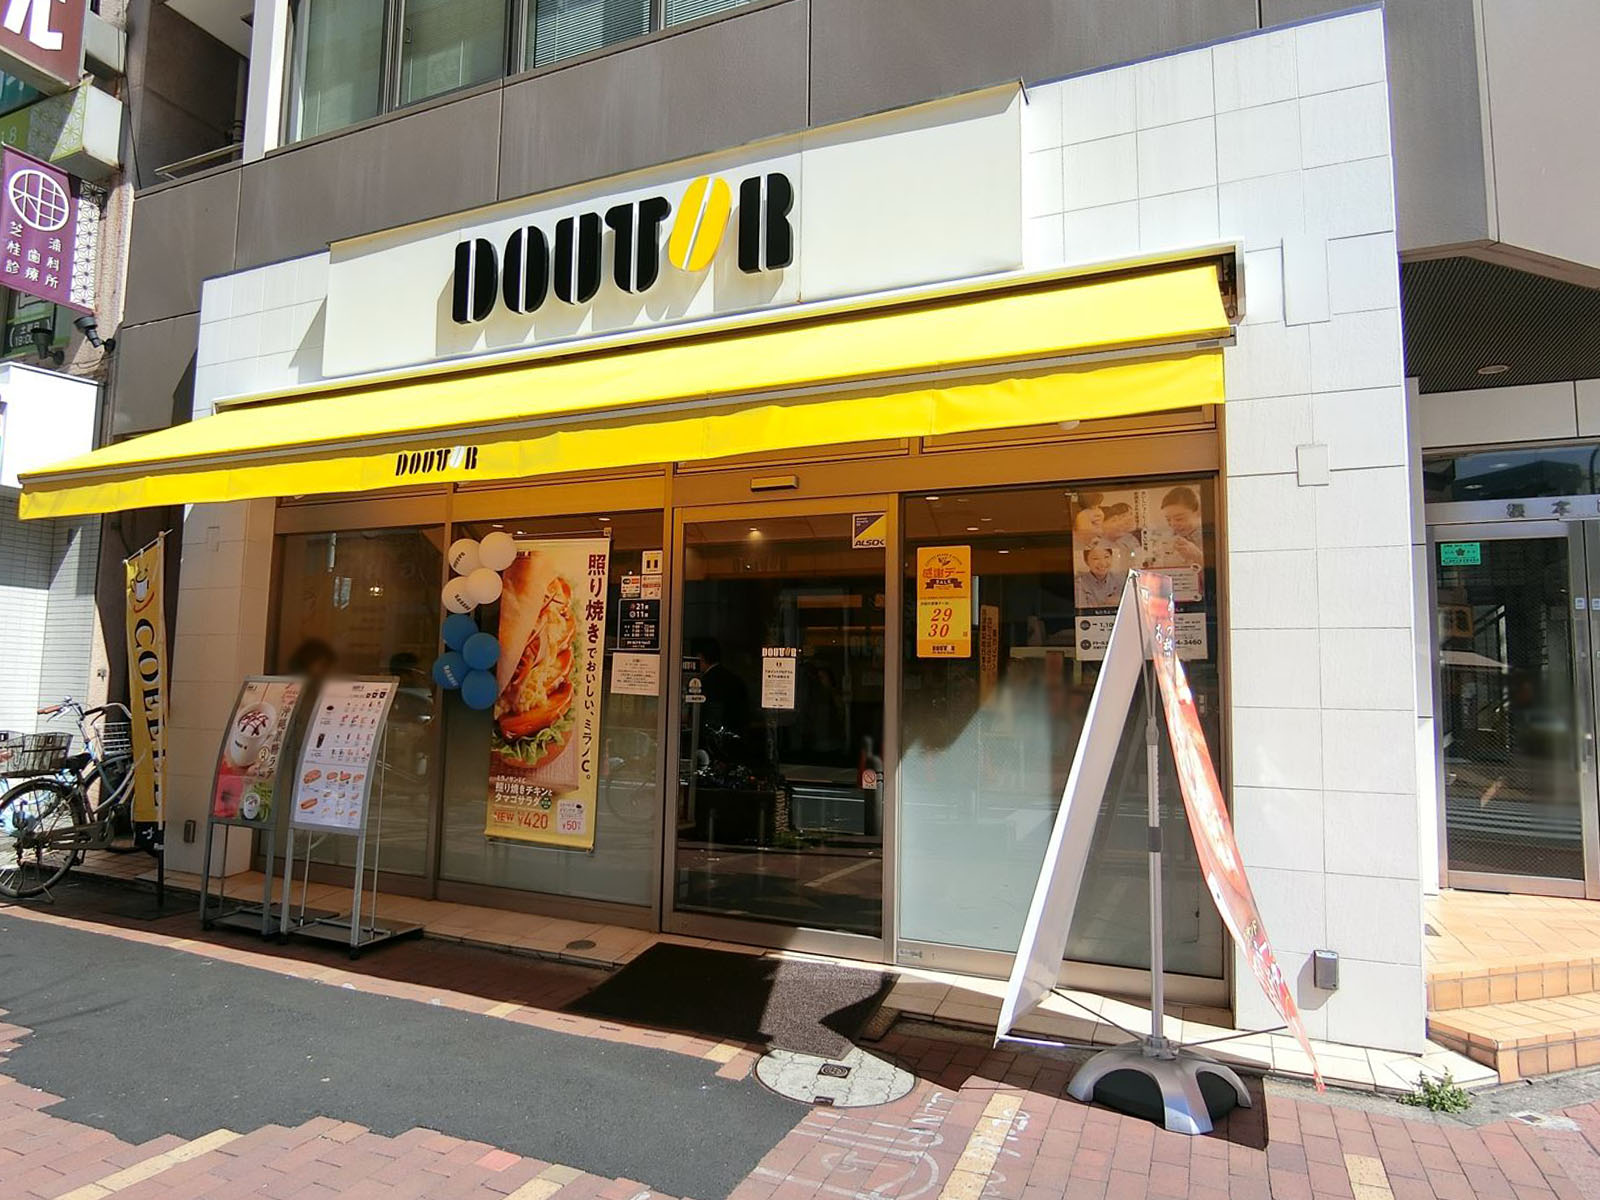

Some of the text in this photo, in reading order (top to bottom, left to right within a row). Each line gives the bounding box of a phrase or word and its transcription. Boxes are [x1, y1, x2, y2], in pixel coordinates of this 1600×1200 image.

[452, 172, 794, 325] DOUTOR
[5, 259, 59, 289] 診療所
[395, 445, 478, 476] DOUTOR
[931, 608, 953, 622] 29
[928, 624, 950, 638] 30
[761, 647, 797, 657] DOUTOR
